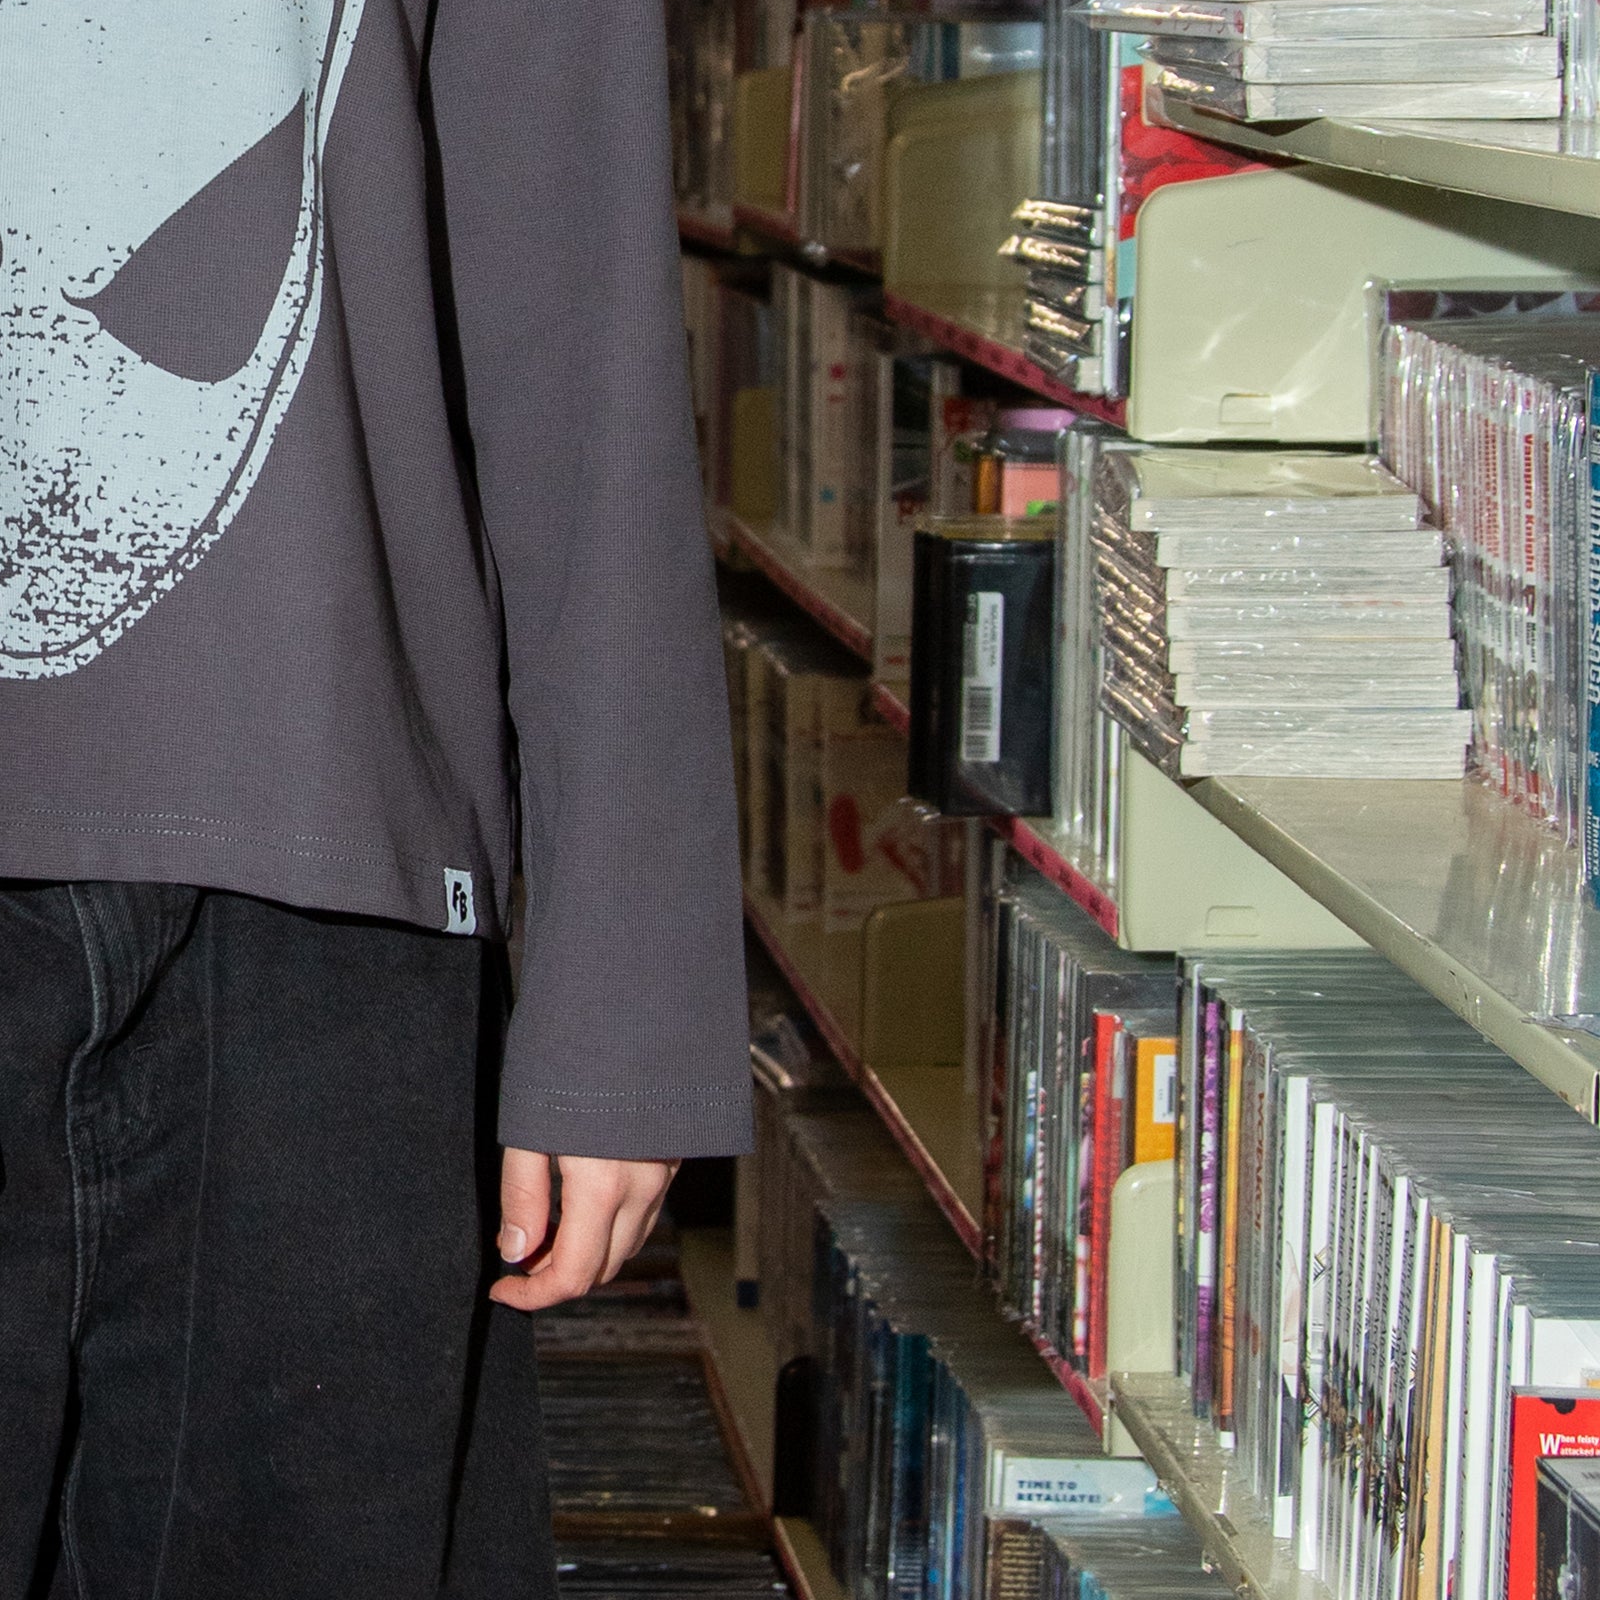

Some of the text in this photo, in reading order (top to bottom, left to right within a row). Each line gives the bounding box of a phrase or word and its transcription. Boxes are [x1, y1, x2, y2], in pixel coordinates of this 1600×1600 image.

[1524, 433, 1536, 572] Vampire Knight
[453, 881, 467, 923] FB
[1577, 1435, 1599, 1446] feisty
[1018, 1480, 1077, 1490] TIME TO
[1017, 1493, 1101, 1503] RETALIATE!
